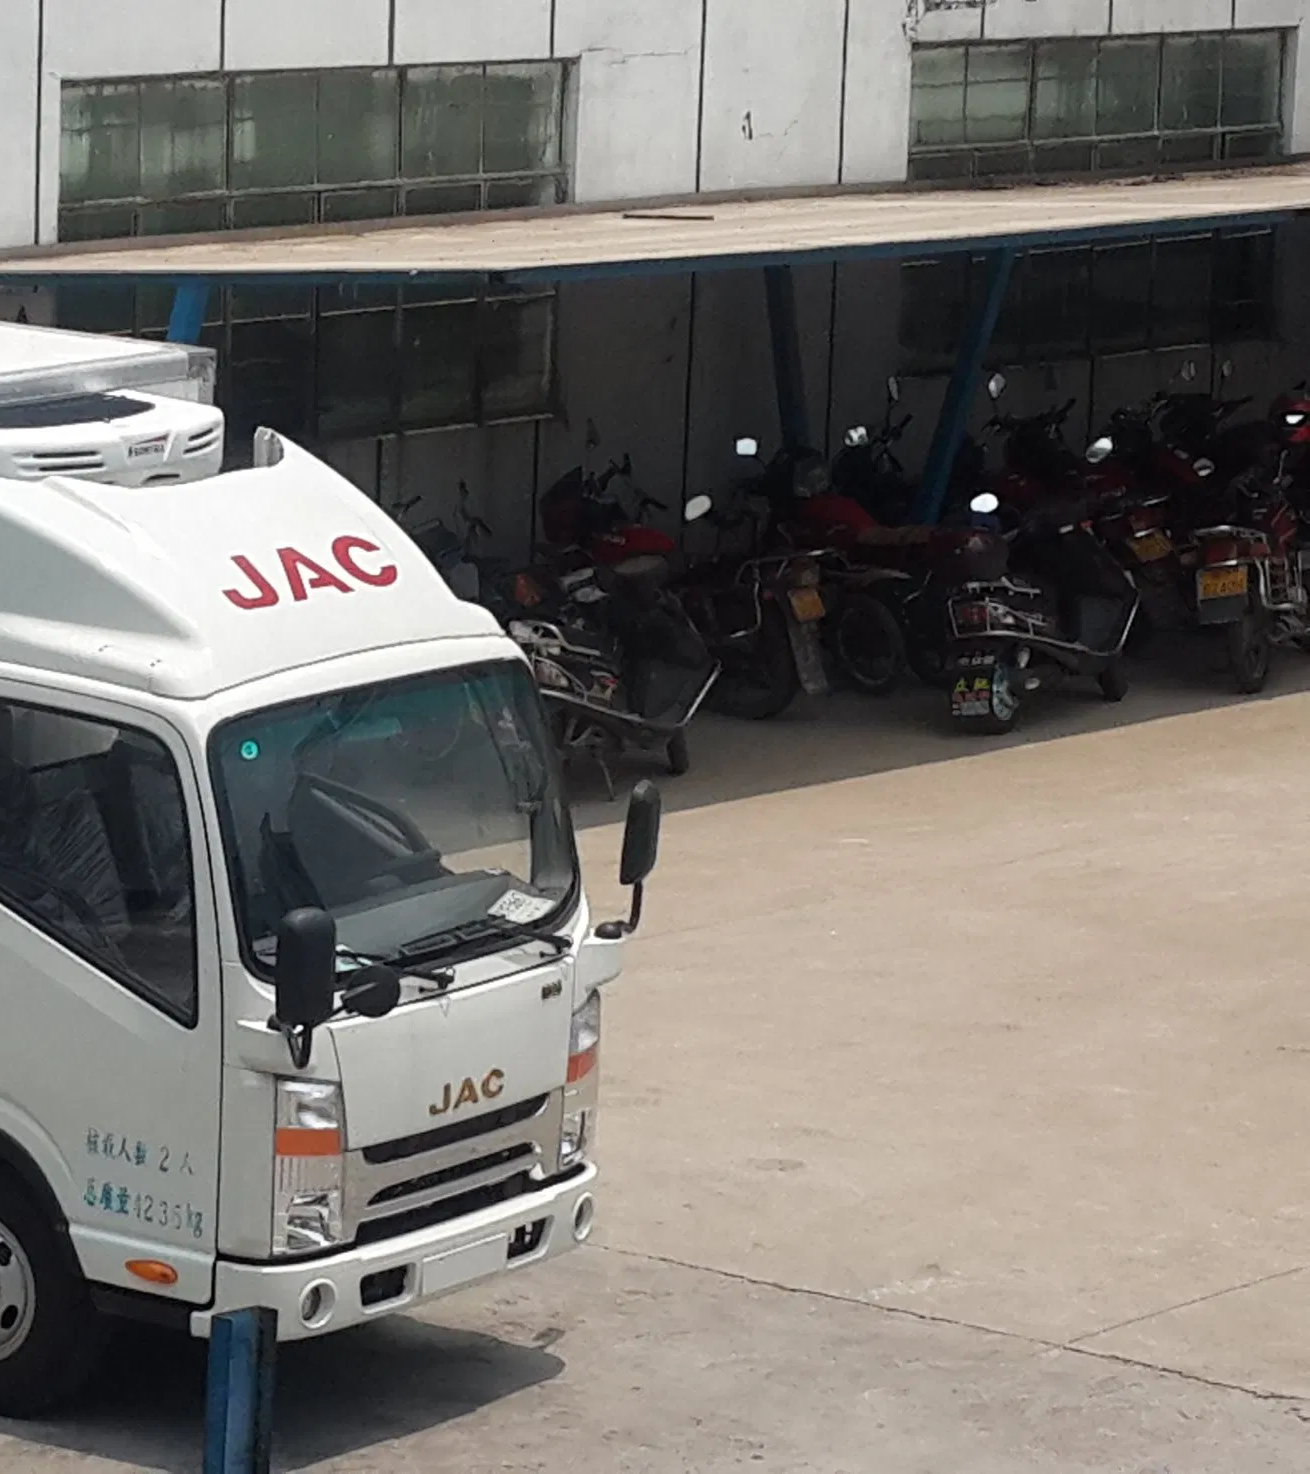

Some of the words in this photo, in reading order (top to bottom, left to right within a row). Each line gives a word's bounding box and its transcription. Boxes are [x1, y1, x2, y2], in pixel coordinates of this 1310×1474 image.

[222, 535, 398, 610] JAC
[429, 1068, 504, 1116] JAC
[158, 1145, 170, 1173] 2
